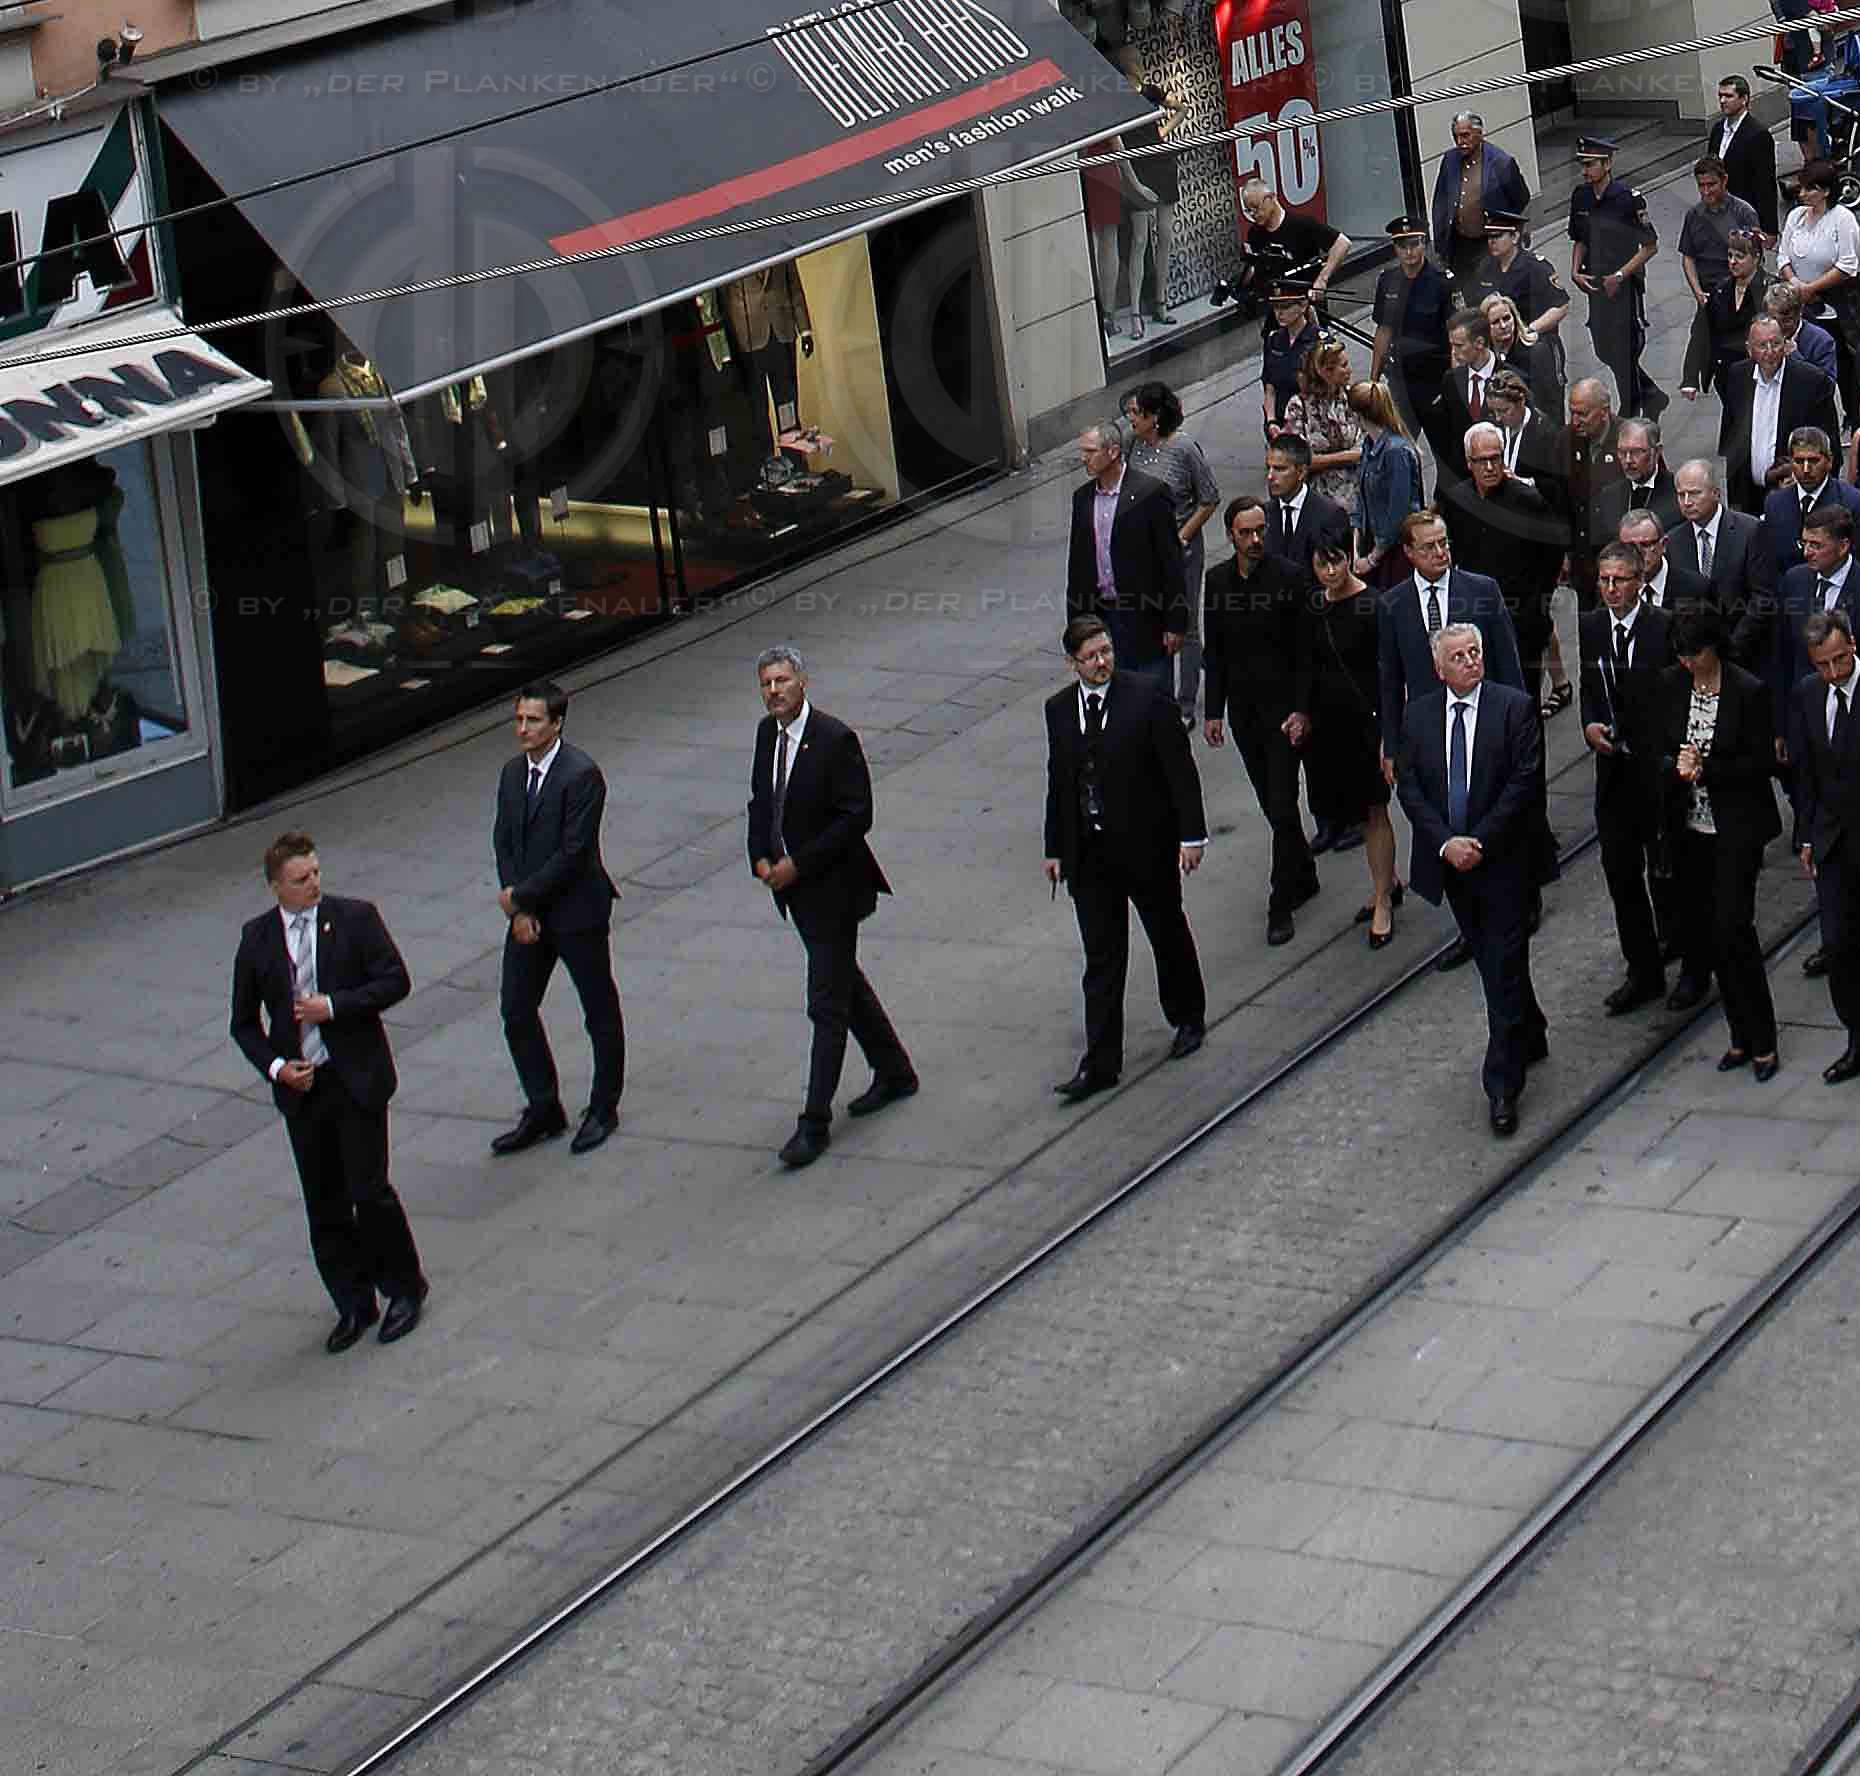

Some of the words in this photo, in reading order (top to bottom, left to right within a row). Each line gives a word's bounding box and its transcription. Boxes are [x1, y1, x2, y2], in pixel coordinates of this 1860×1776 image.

[1231, 20, 1306, 88] ALLES
[884, 141, 950, 177] men's
[948, 105, 1033, 152] fashion
[1031, 83, 1085, 117] walk
